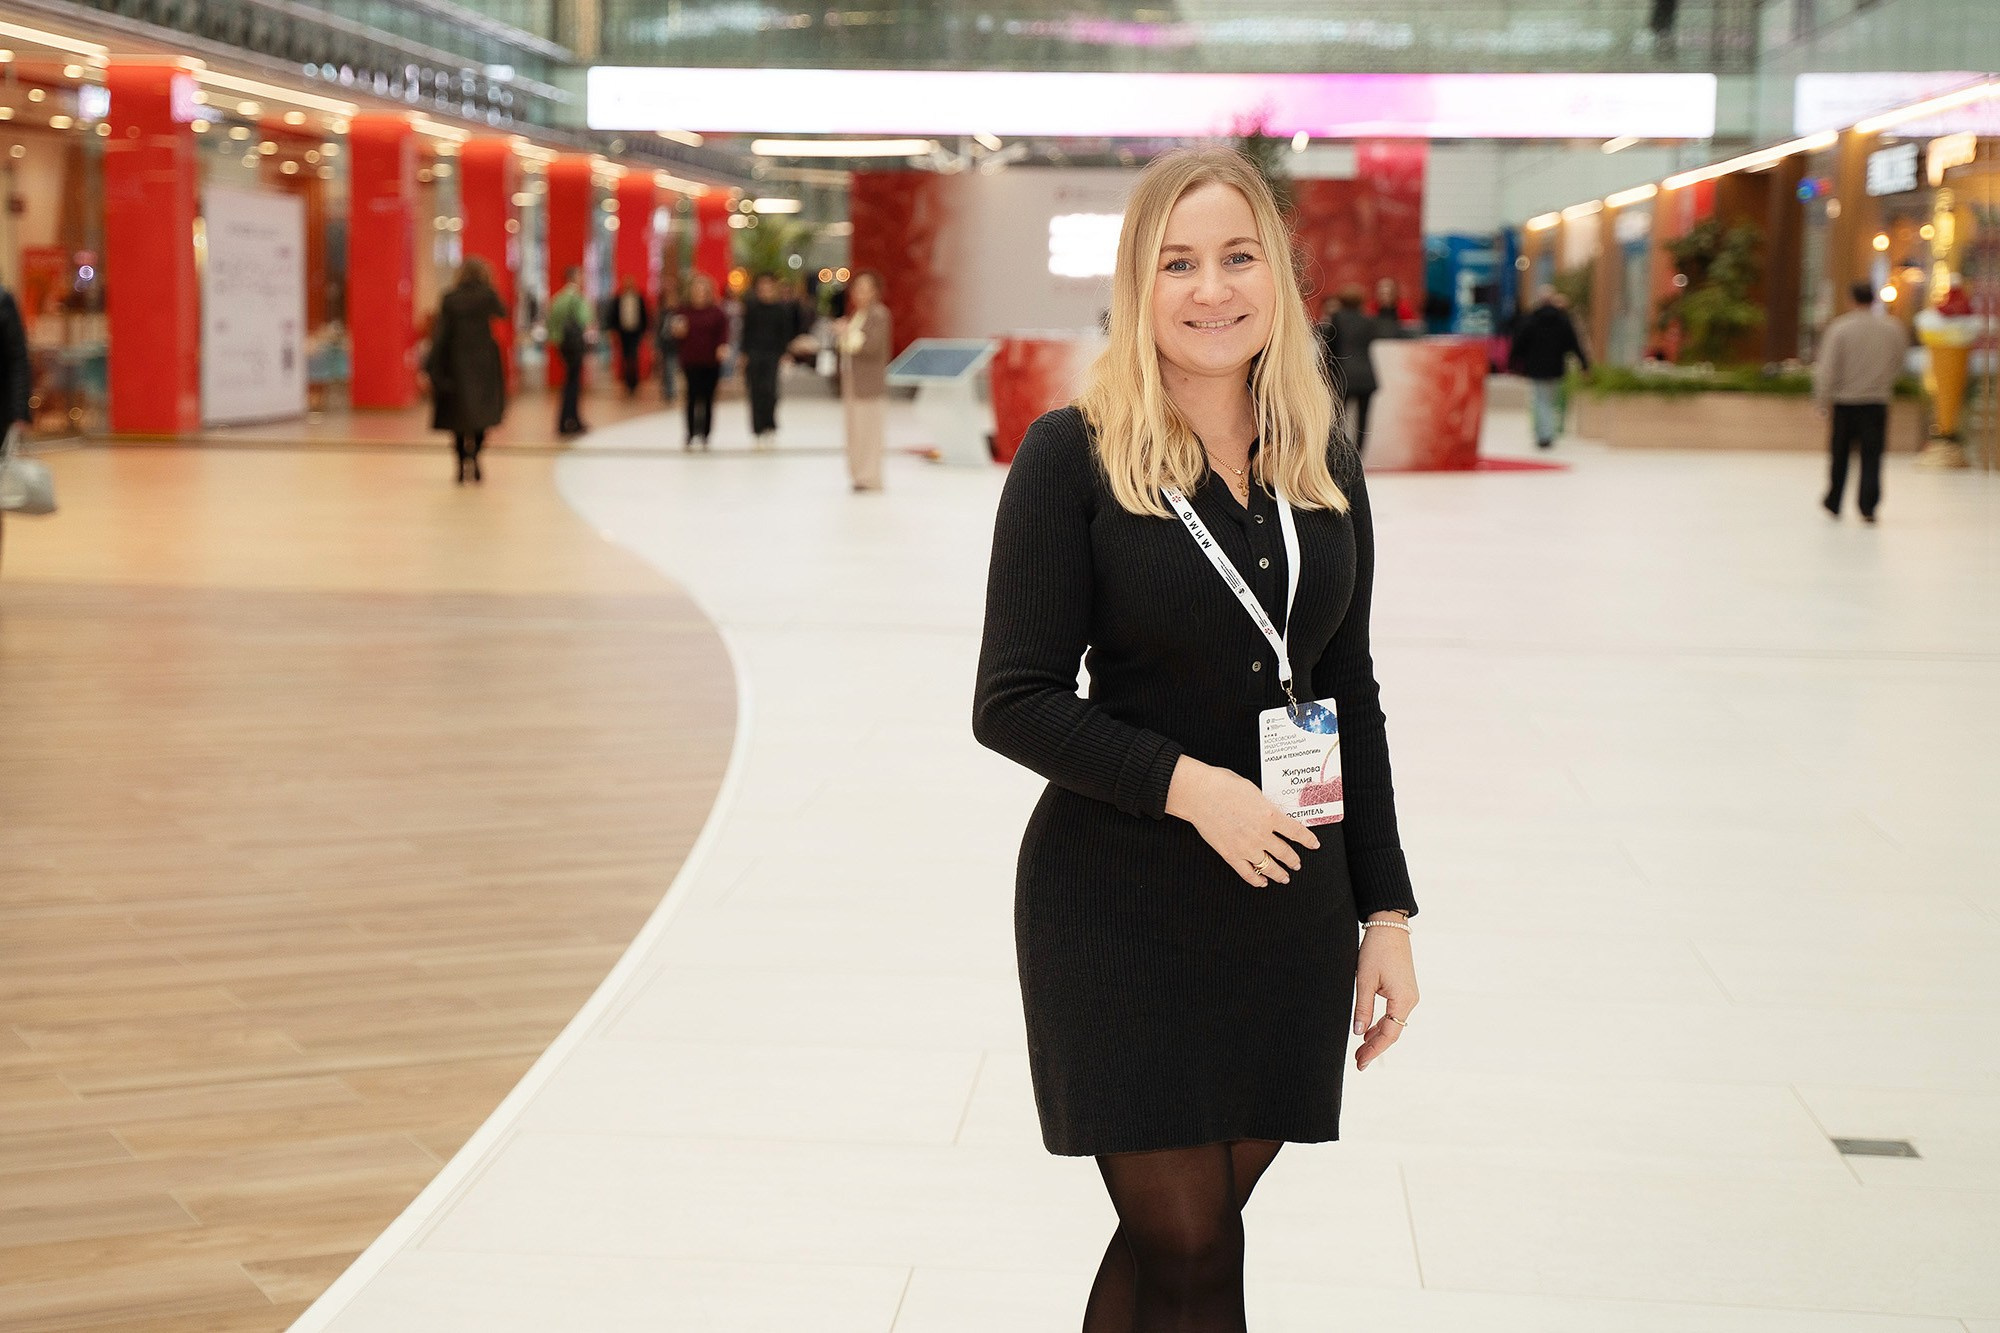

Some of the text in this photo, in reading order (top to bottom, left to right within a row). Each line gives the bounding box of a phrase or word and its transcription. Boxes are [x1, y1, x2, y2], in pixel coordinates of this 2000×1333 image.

[1282, 766, 1320, 777] Жигунова
[1291, 777, 1312, 785] Юлия
[1282, 788, 1296, 796] ООО
[1286, 808, 1324, 818] ОСЕТИТЕЛЬ
